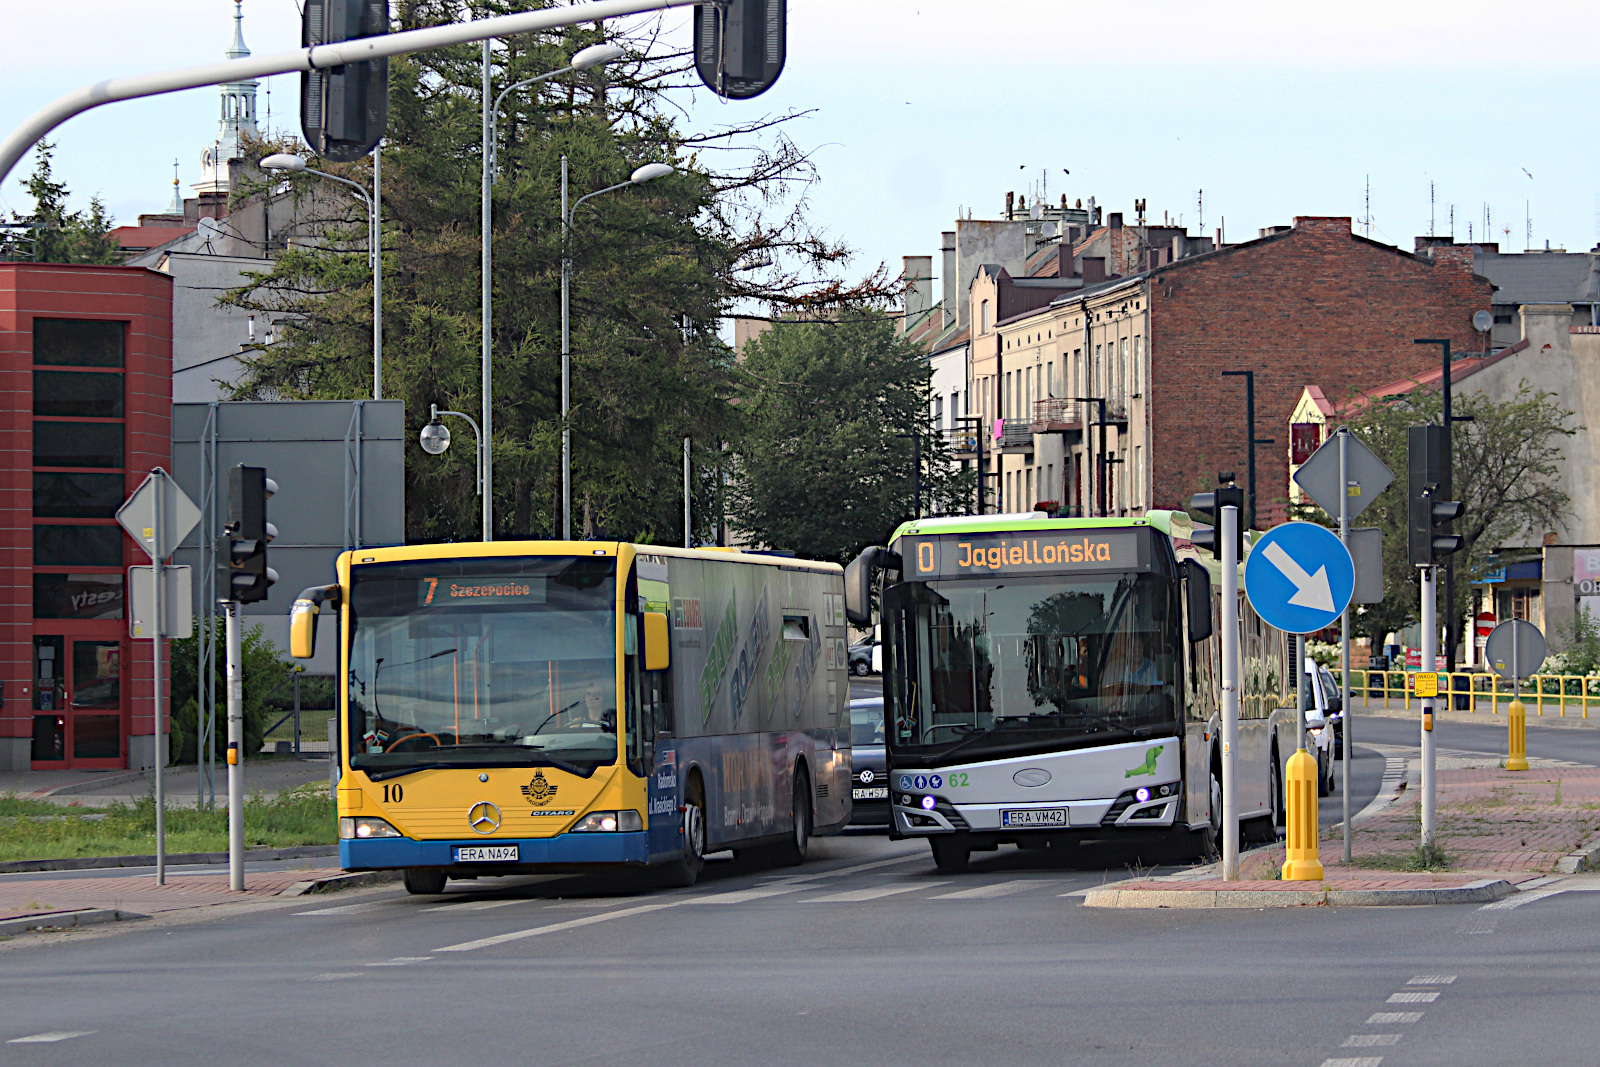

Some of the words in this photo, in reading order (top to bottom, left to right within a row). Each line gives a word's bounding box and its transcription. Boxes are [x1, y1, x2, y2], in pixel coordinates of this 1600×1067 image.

[958, 538, 1111, 569] Jagiellońska
[424, 577, 438, 604] 7
[949, 773, 969, 788] 62
[382, 784, 403, 803] 10
[1010, 812, 1031, 823] ERA
[1035, 811, 1062, 822] VM42
[460, 849, 485, 860] ERA
[488, 848, 516, 860] NA94
